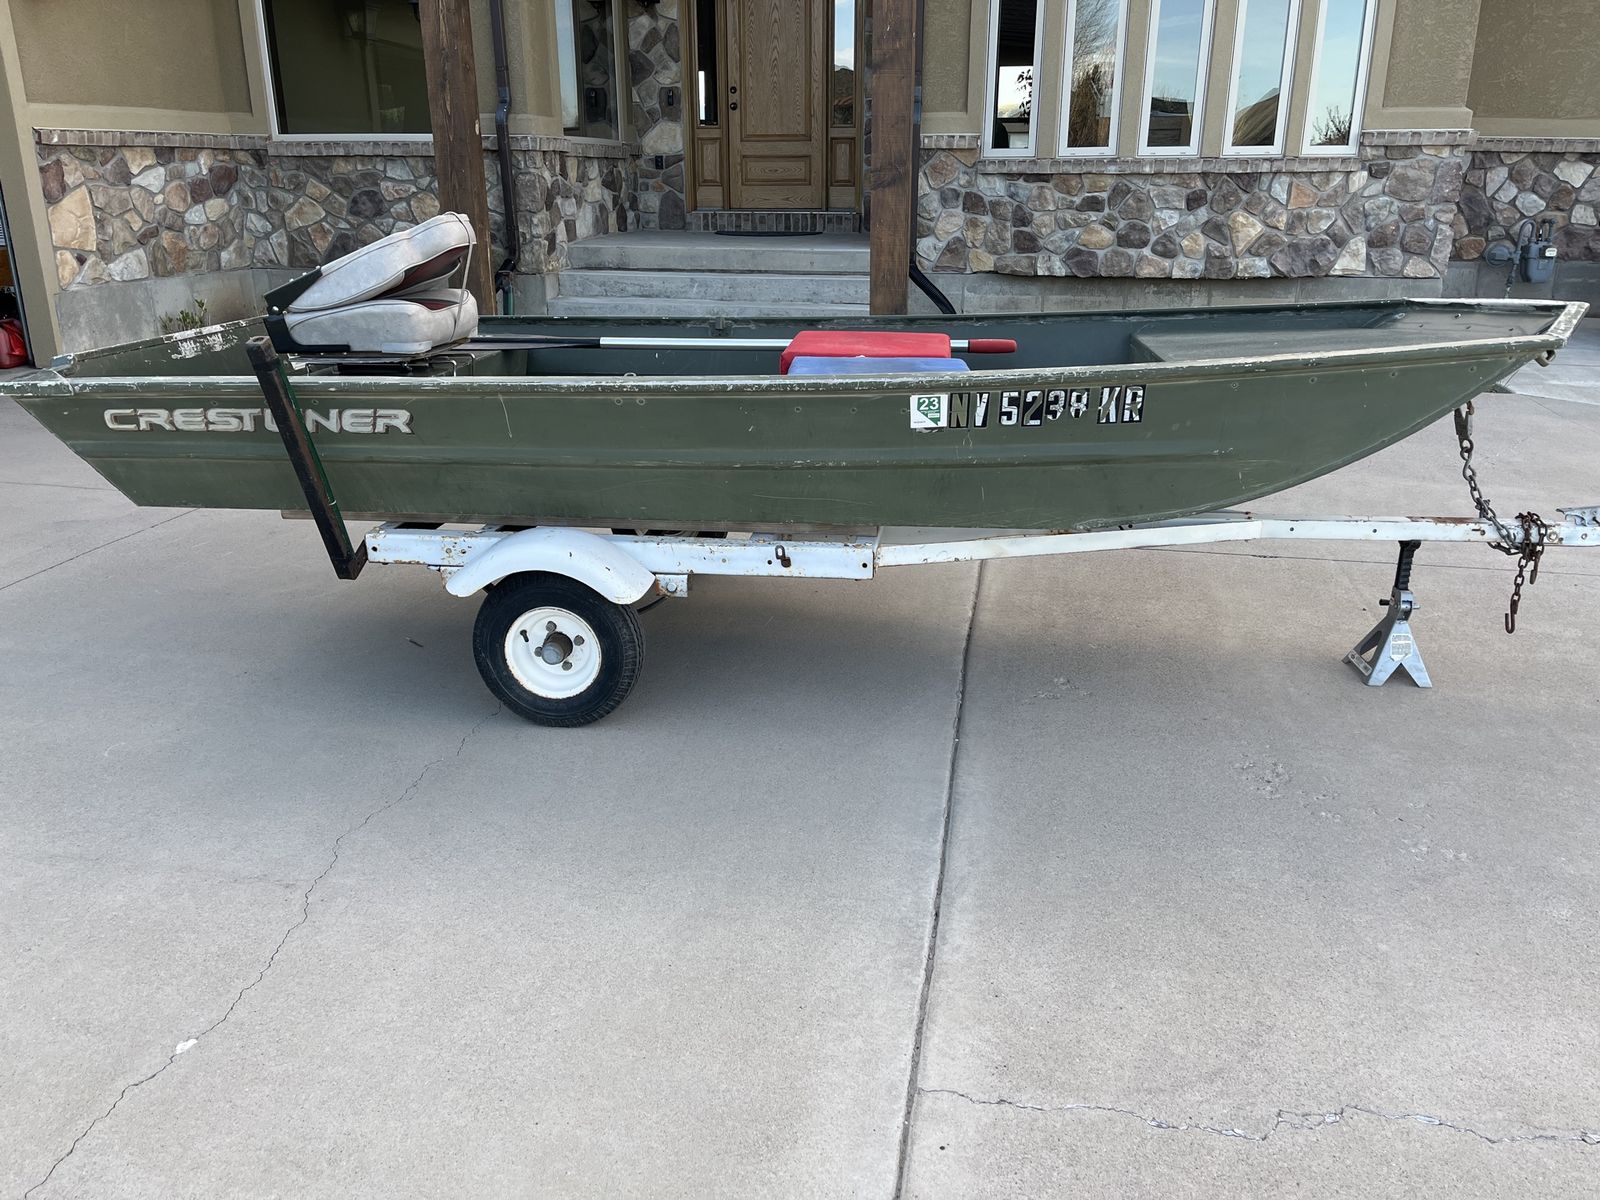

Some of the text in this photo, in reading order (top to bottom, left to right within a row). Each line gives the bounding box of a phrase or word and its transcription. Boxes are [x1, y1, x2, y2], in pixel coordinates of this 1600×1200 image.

[919, 397, 939, 411] 23
[950, 393, 989, 427] NV
[104, 408, 413, 433] CRESTLNER
